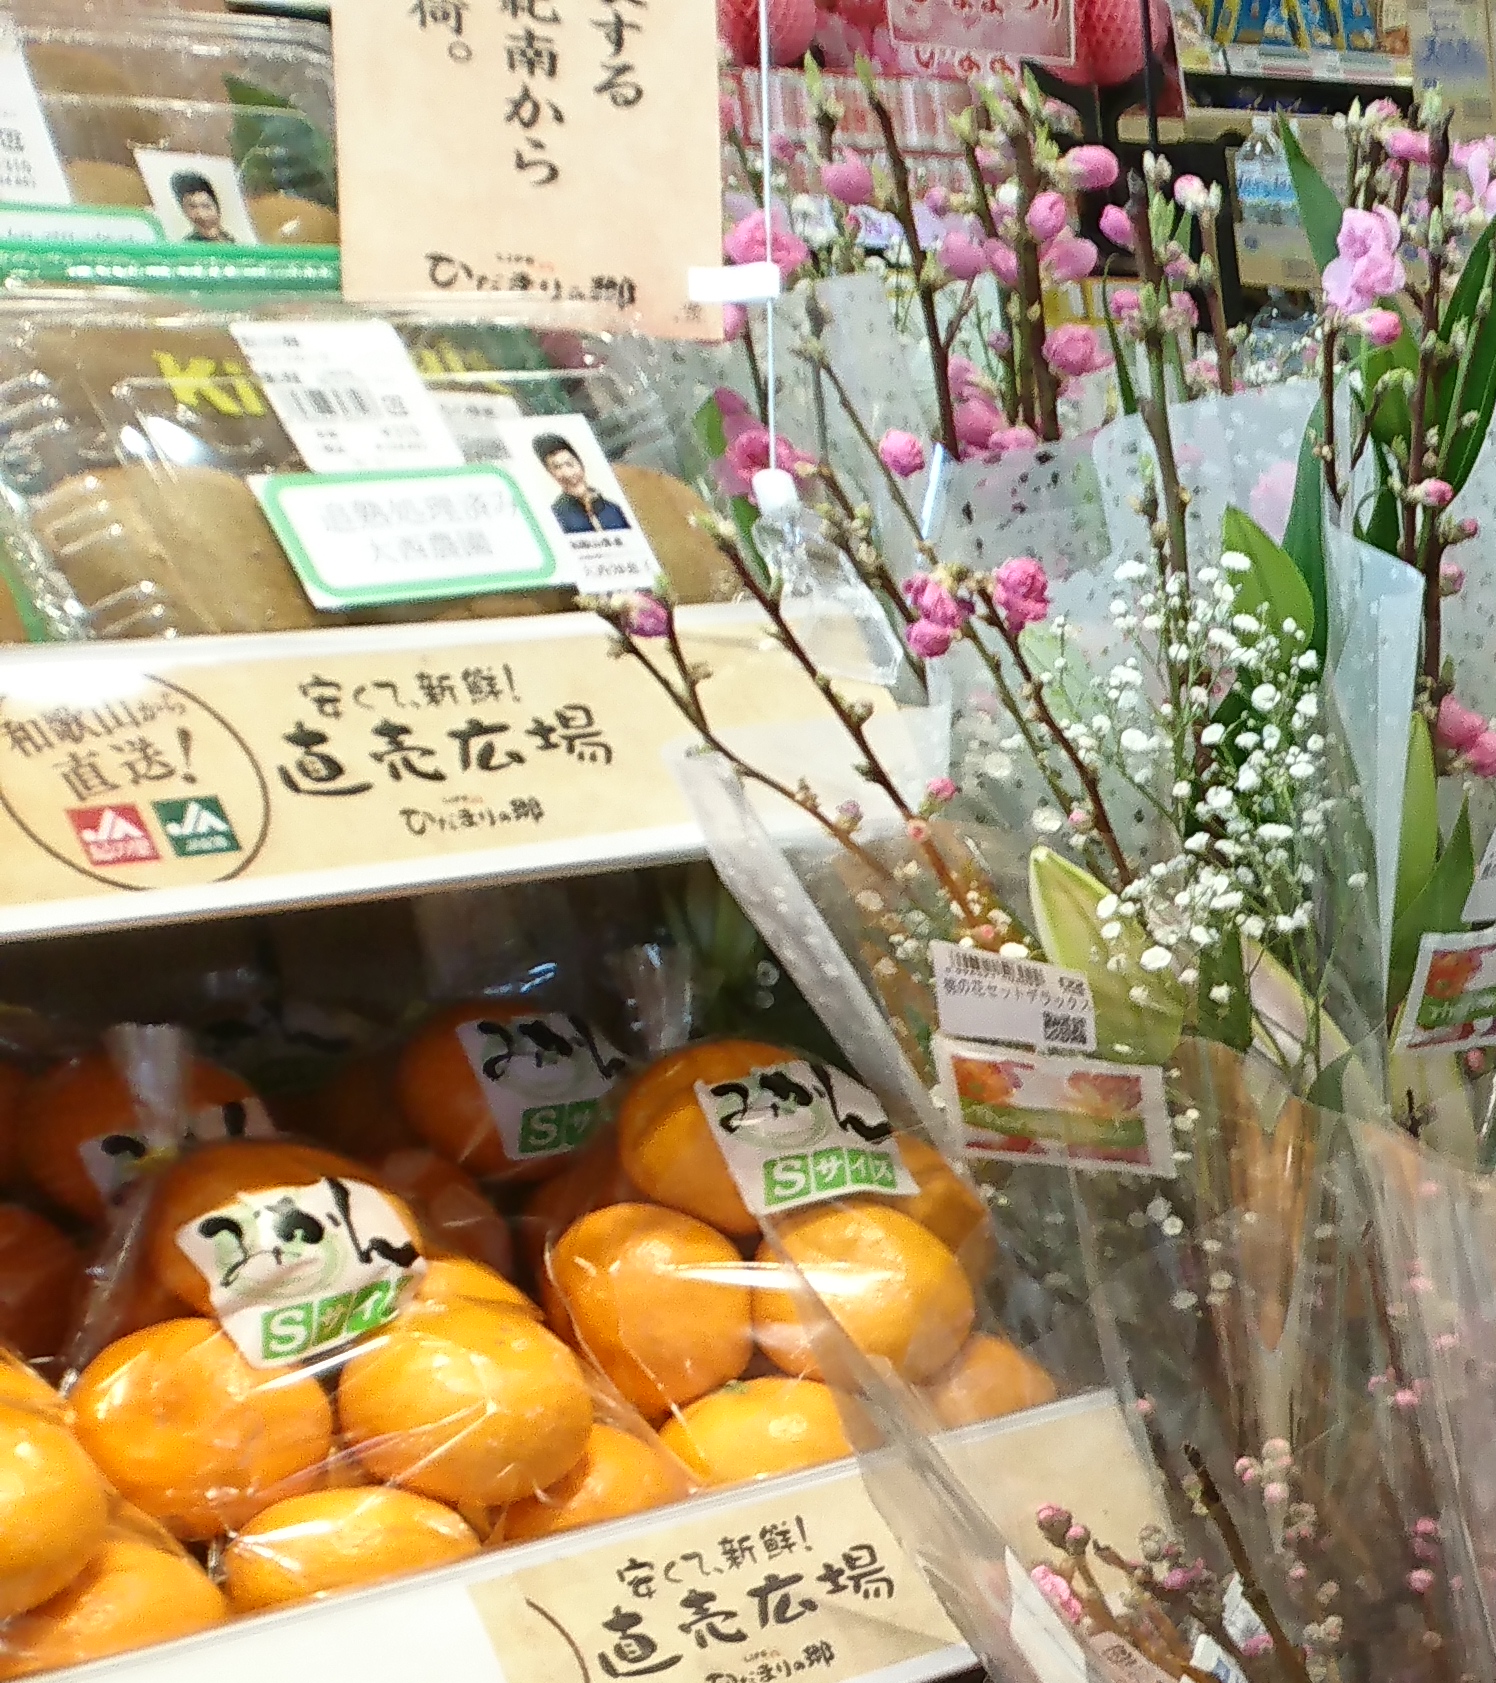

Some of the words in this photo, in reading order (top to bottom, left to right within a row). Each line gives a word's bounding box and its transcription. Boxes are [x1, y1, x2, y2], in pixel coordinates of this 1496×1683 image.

[590, 0, 648, 108] する
[277, 702, 613, 797] 直売広場
[599, 1543, 895, 1679] 直売広場
